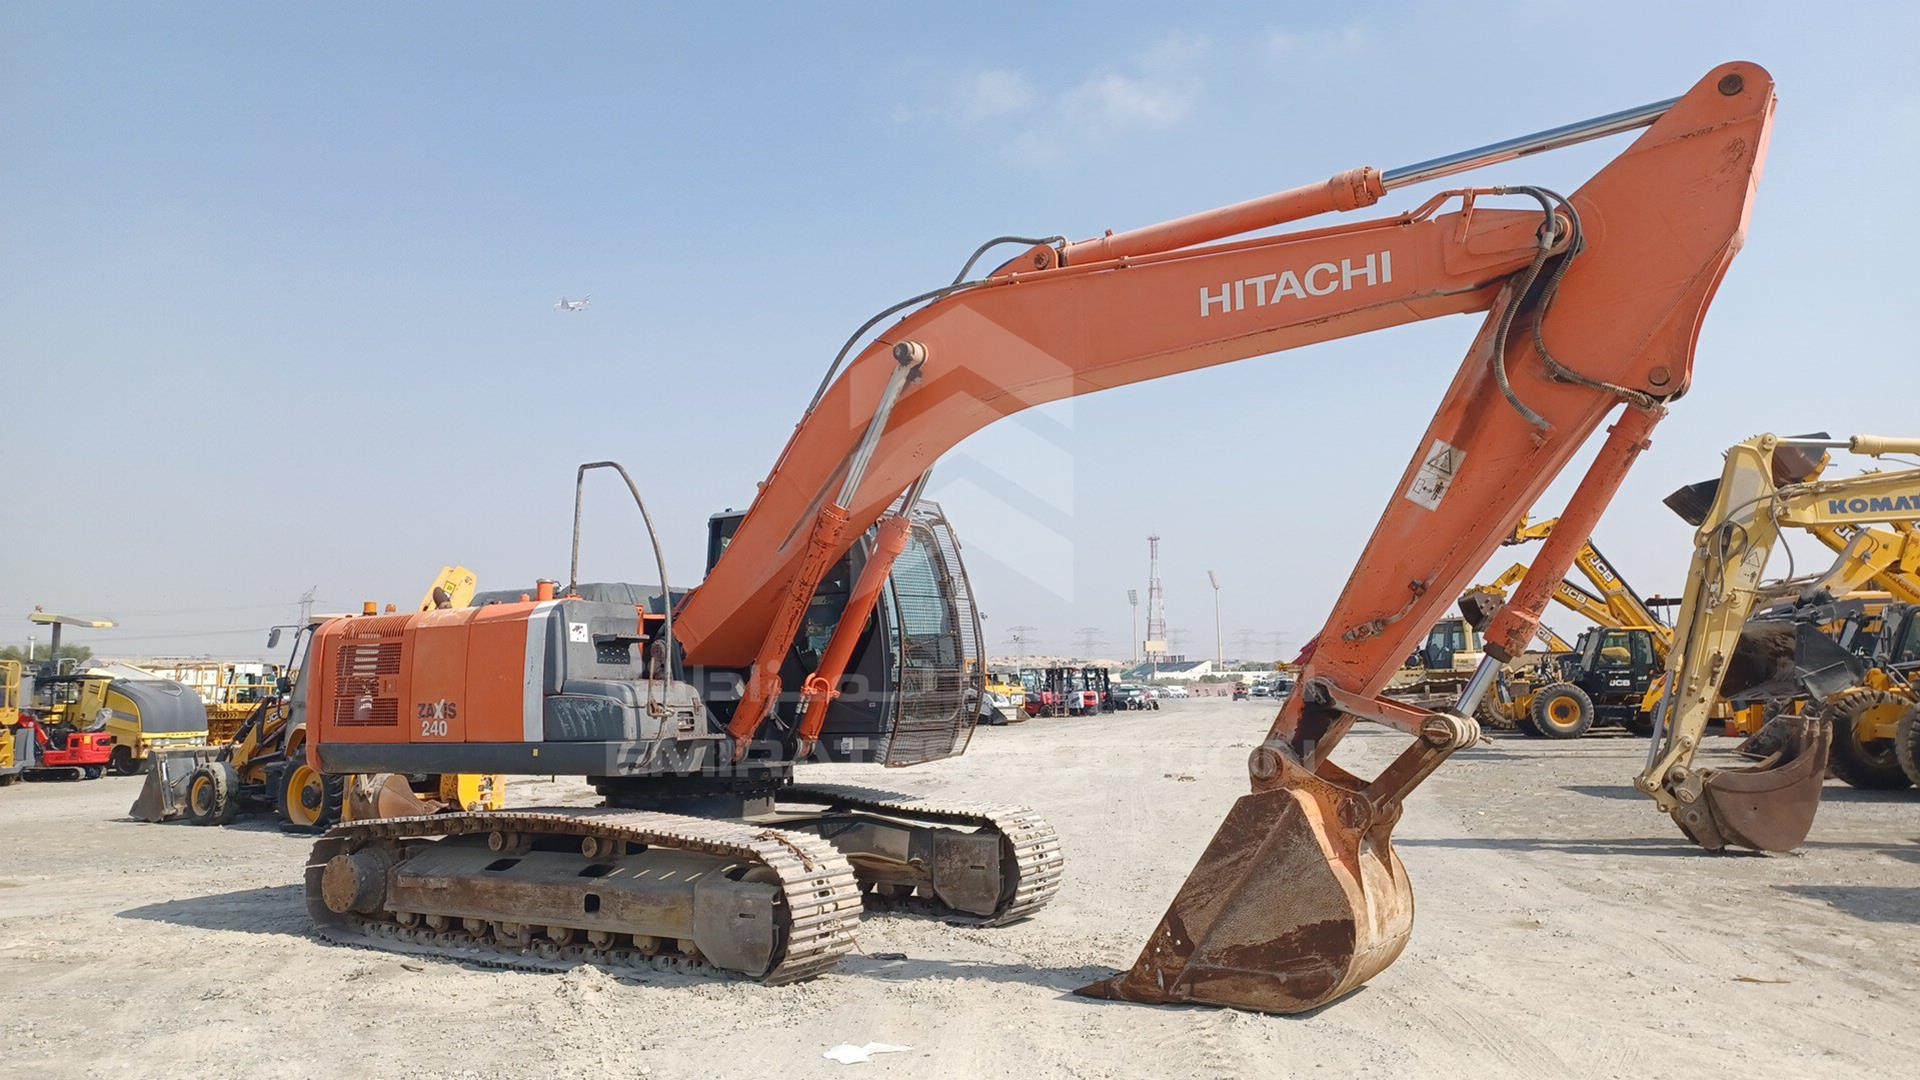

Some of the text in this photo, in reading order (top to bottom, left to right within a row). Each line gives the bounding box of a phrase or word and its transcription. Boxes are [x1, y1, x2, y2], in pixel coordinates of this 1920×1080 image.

[1200, 250, 1392, 317] HITACHI
[1835, 527, 1855, 541] JC
[1590, 556, 1614, 582] JCB
[1562, 586, 1587, 603] JCB
[1537, 630, 1551, 641] CB
[417, 699, 457, 719] ZAXIS
[421, 720, 448, 737] 240
